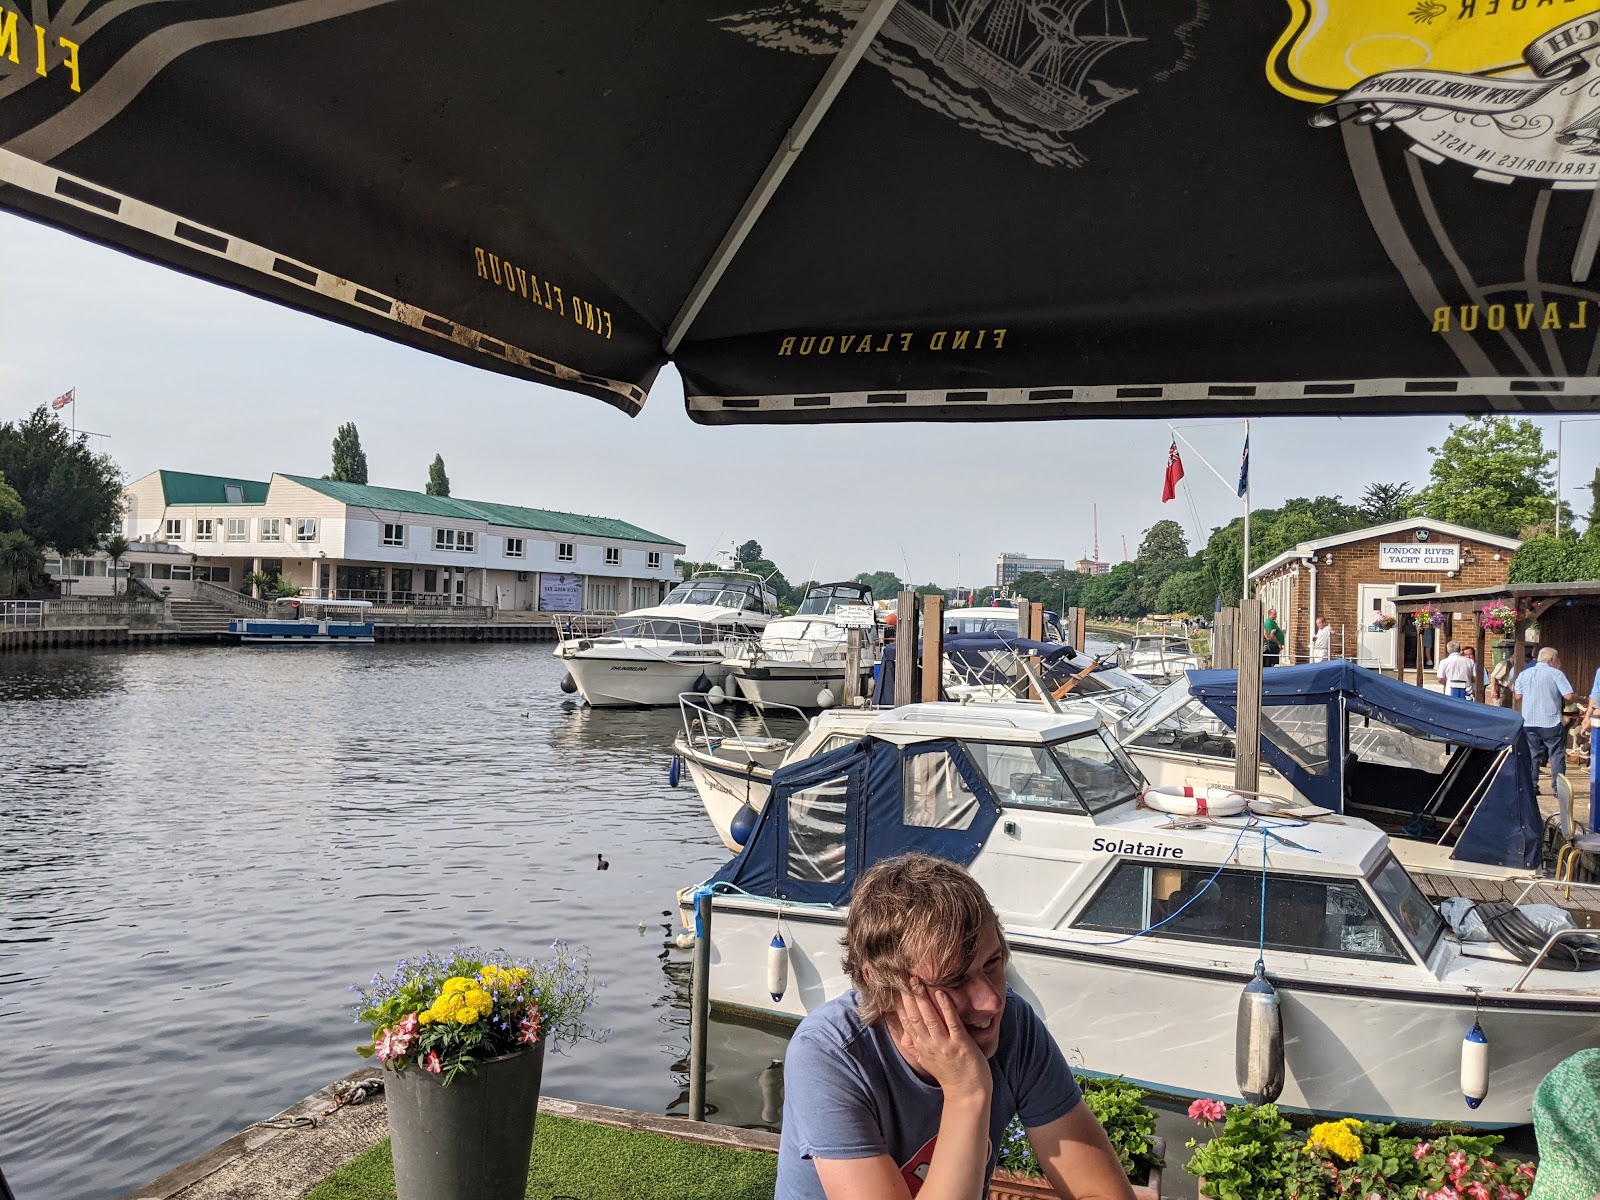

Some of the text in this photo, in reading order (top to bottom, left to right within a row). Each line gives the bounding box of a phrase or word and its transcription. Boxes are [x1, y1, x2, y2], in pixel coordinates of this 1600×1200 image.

[1383, 547, 1422, 555] LONDON
[1389, 556, 1449, 564] YACHT CLUB
[1092, 837, 1184, 859] Solataire
